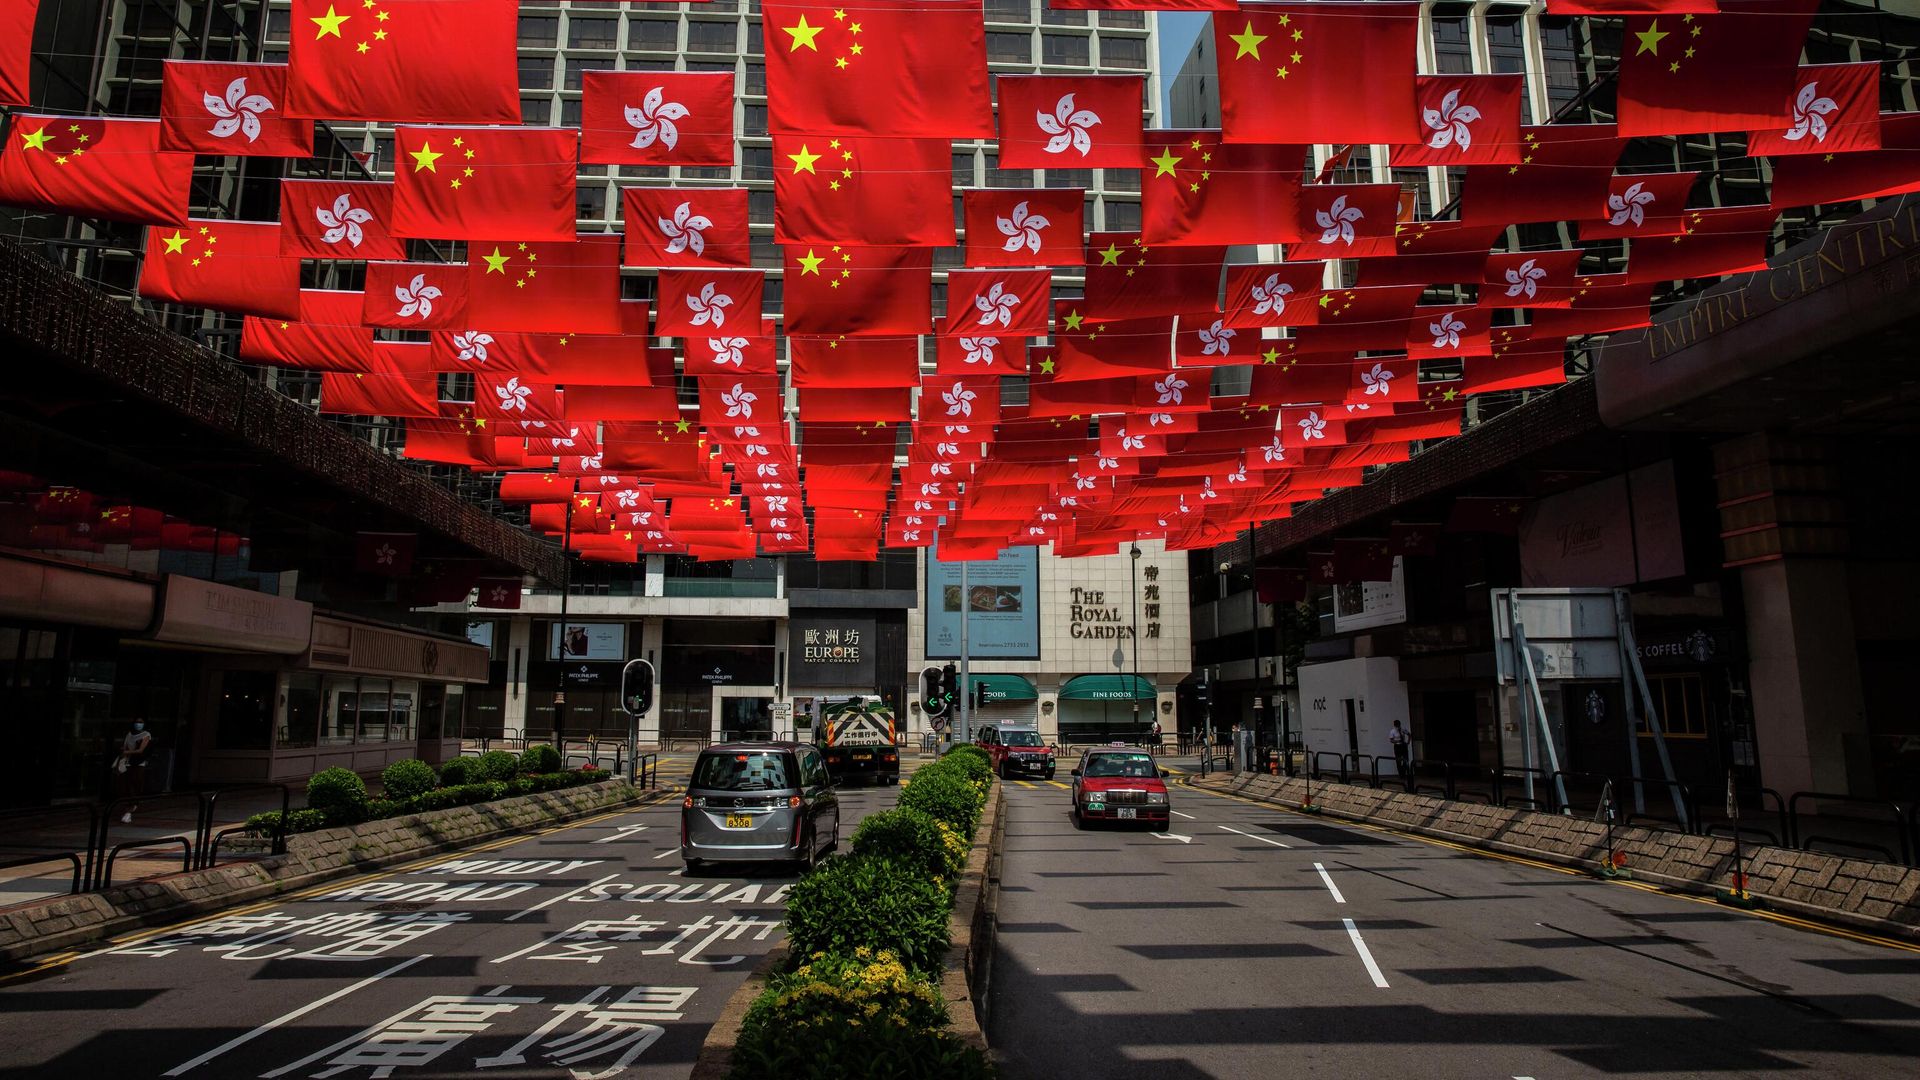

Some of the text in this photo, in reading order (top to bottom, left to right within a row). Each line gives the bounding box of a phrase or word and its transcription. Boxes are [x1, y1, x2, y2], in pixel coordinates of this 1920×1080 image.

[1648, 288, 1755, 358] EMPIRE
[1070, 587, 1104, 604] THE
[1144, 565, 1160, 639] 帝苑酒店
[1070, 605, 1121, 621] ROYAL
[804, 629, 859, 645] 歐洲坊
[1070, 622, 1135, 639] GARDEN
[805, 646, 860, 658] EUROPE
[1645, 643, 1685, 657] COFFEE
[728, 819, 750, 828] 8308
[406, 860, 606, 876] MODY
[306, 882, 541, 902] ROAD
[257, 985, 699, 1080] 廣場
